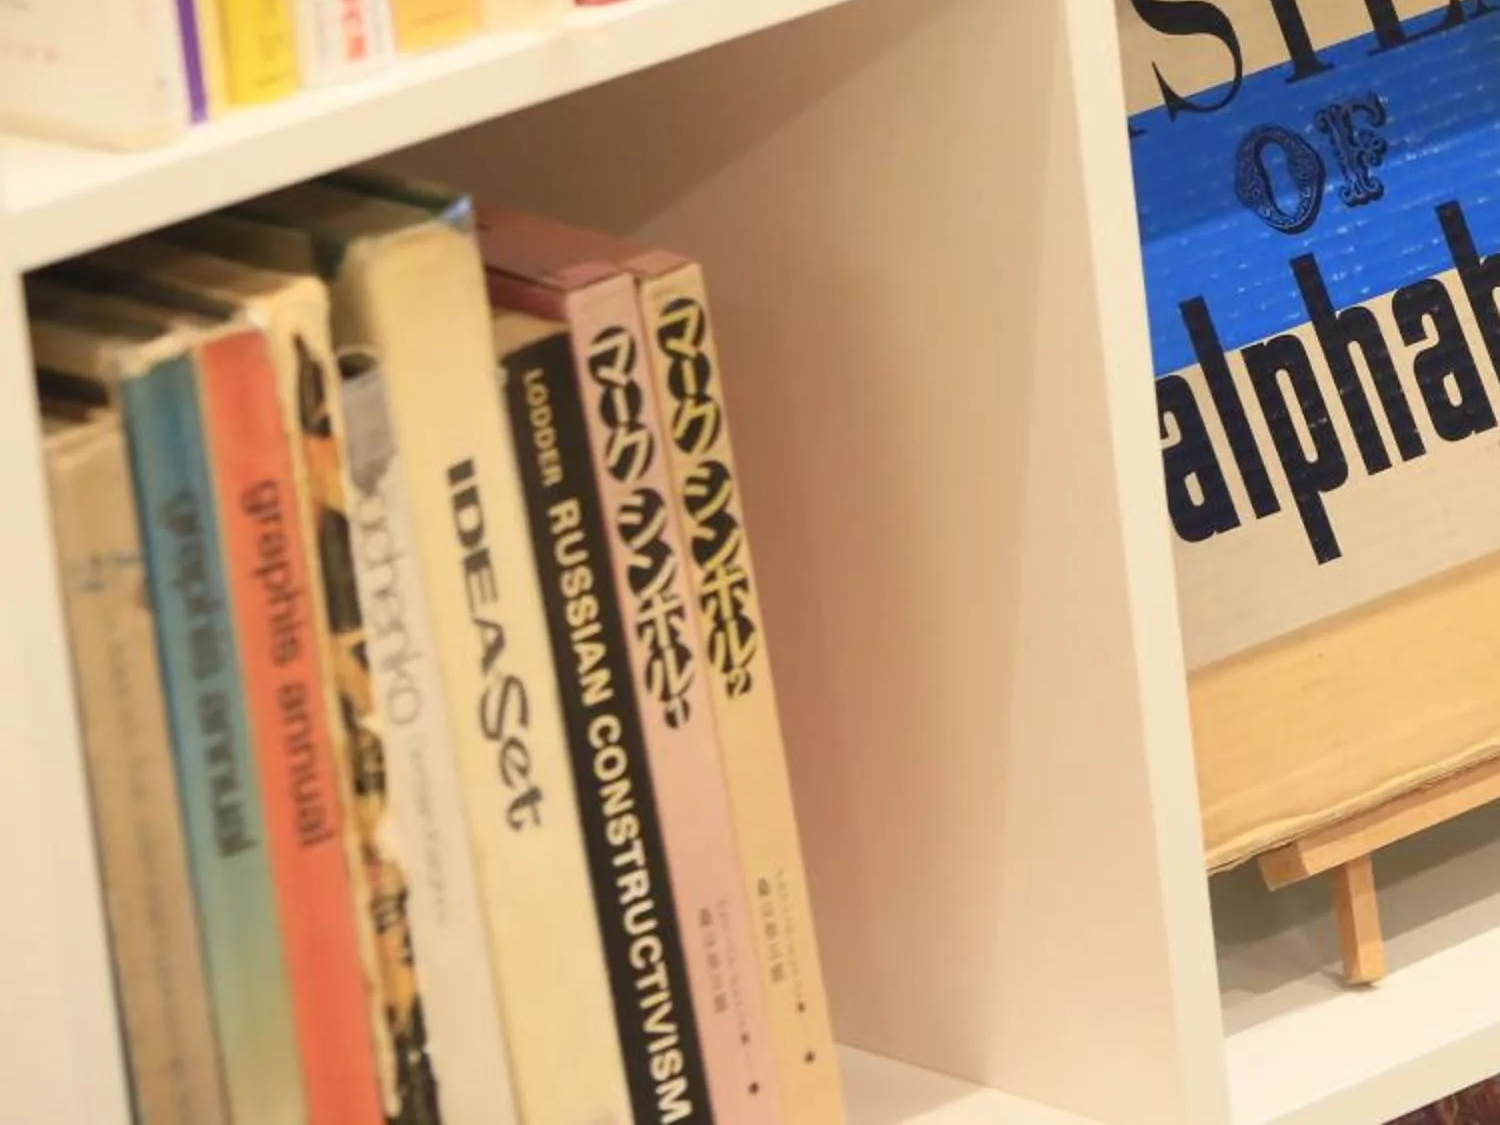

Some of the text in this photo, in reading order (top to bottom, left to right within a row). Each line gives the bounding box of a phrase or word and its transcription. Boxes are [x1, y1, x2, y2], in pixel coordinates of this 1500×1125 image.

[1233, 90, 1391, 236] OF
[238, 479, 340, 849] graphis annual
[522, 366, 693, 1125] LODDER RUSSIAN CONSTRUCTIVISM
